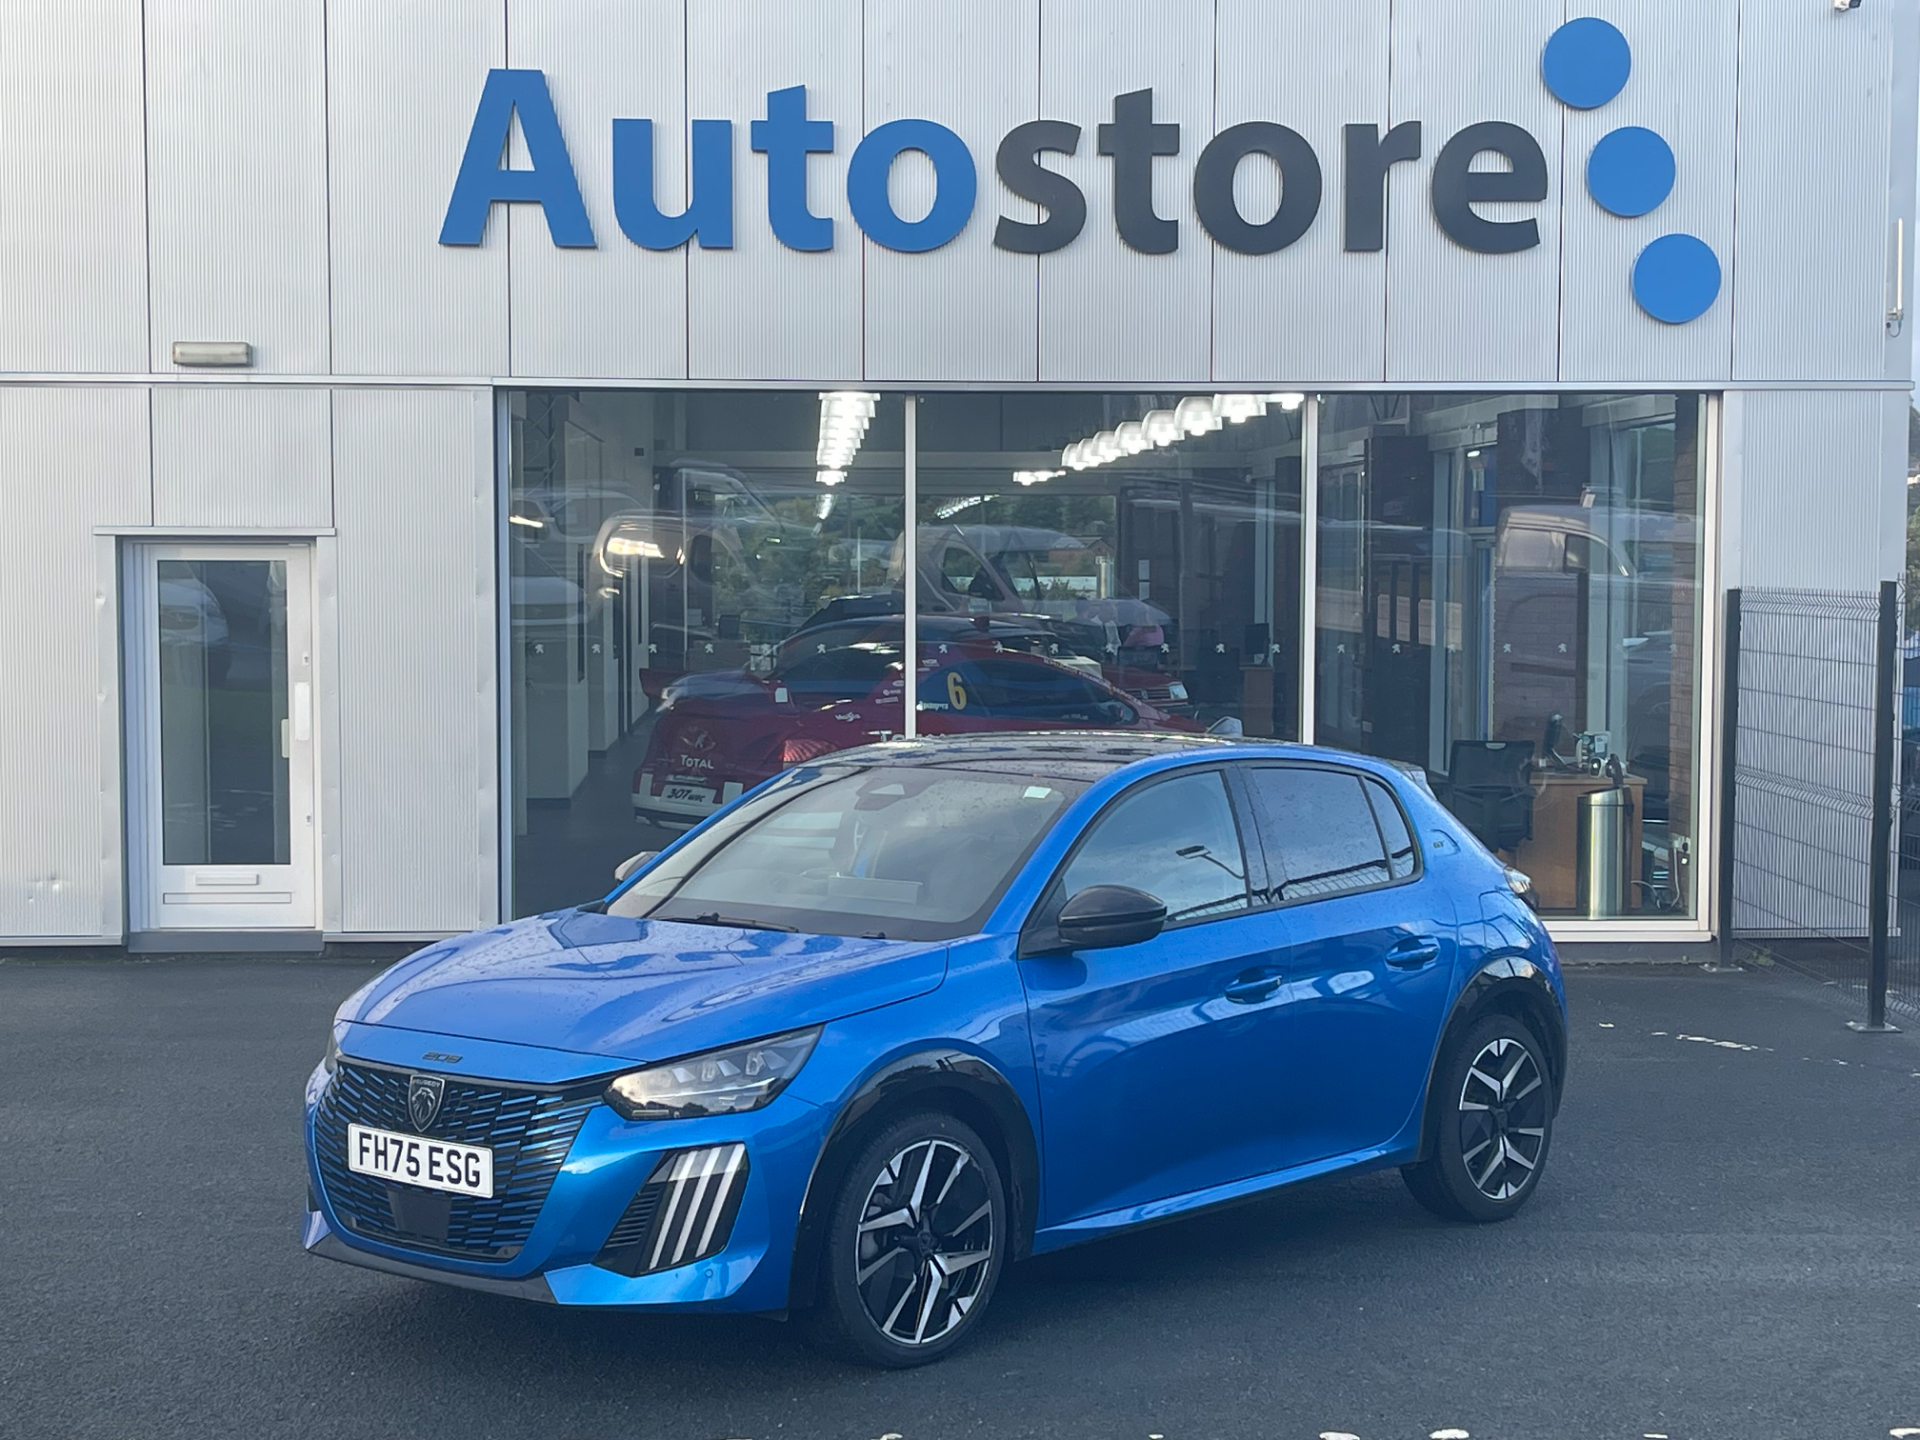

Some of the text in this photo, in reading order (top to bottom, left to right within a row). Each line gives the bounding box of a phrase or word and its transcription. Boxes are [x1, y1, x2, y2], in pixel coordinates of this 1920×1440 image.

[438, 68, 1550, 256] Autostore
[947, 671, 967, 710] 6
[666, 788, 692, 800] 307
[422, 1051, 463, 1064] 208
[358, 1131, 481, 1188] FH75 ESG
